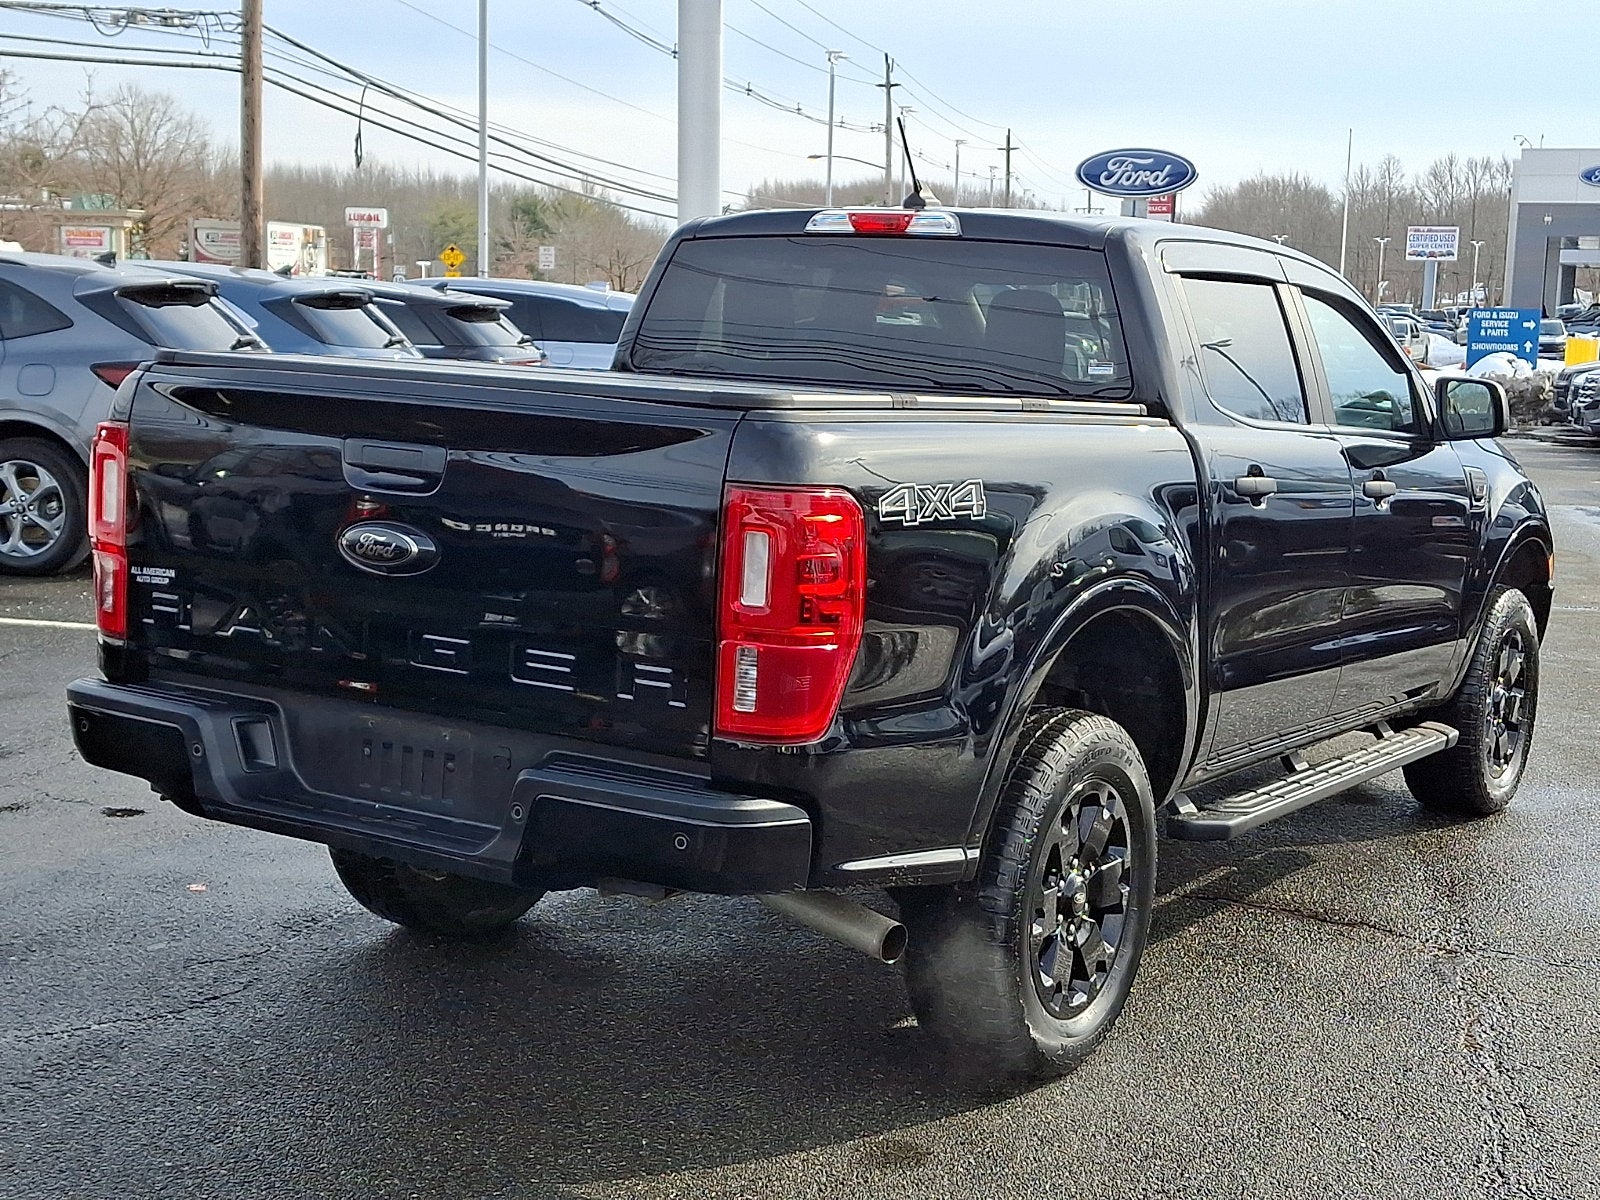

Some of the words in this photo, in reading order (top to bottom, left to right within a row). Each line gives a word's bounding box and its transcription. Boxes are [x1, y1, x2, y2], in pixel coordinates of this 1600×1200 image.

[1100, 156, 1172, 186] Ford
[348, 213, 381, 221] LUKOIL
[1408, 233, 1439, 242] CERTIFIED
[1440, 233, 1456, 242] USED
[1473, 311, 1491, 319] FORD
[1492, 311, 1498, 319] &
[1499, 311, 1519, 319] ISUZU
[1481, 319, 1509, 328] SERVICE
[1480, 328, 1486, 336] &
[1487, 328, 1509, 336] PARTS
[1471, 342, 1519, 351] SHOWROOMS
[356, 532, 397, 558] Ford
[131, 566, 142, 574] ALL
[142, 567, 176, 577] AMERICAN
[141, 591, 688, 708] RANGER
